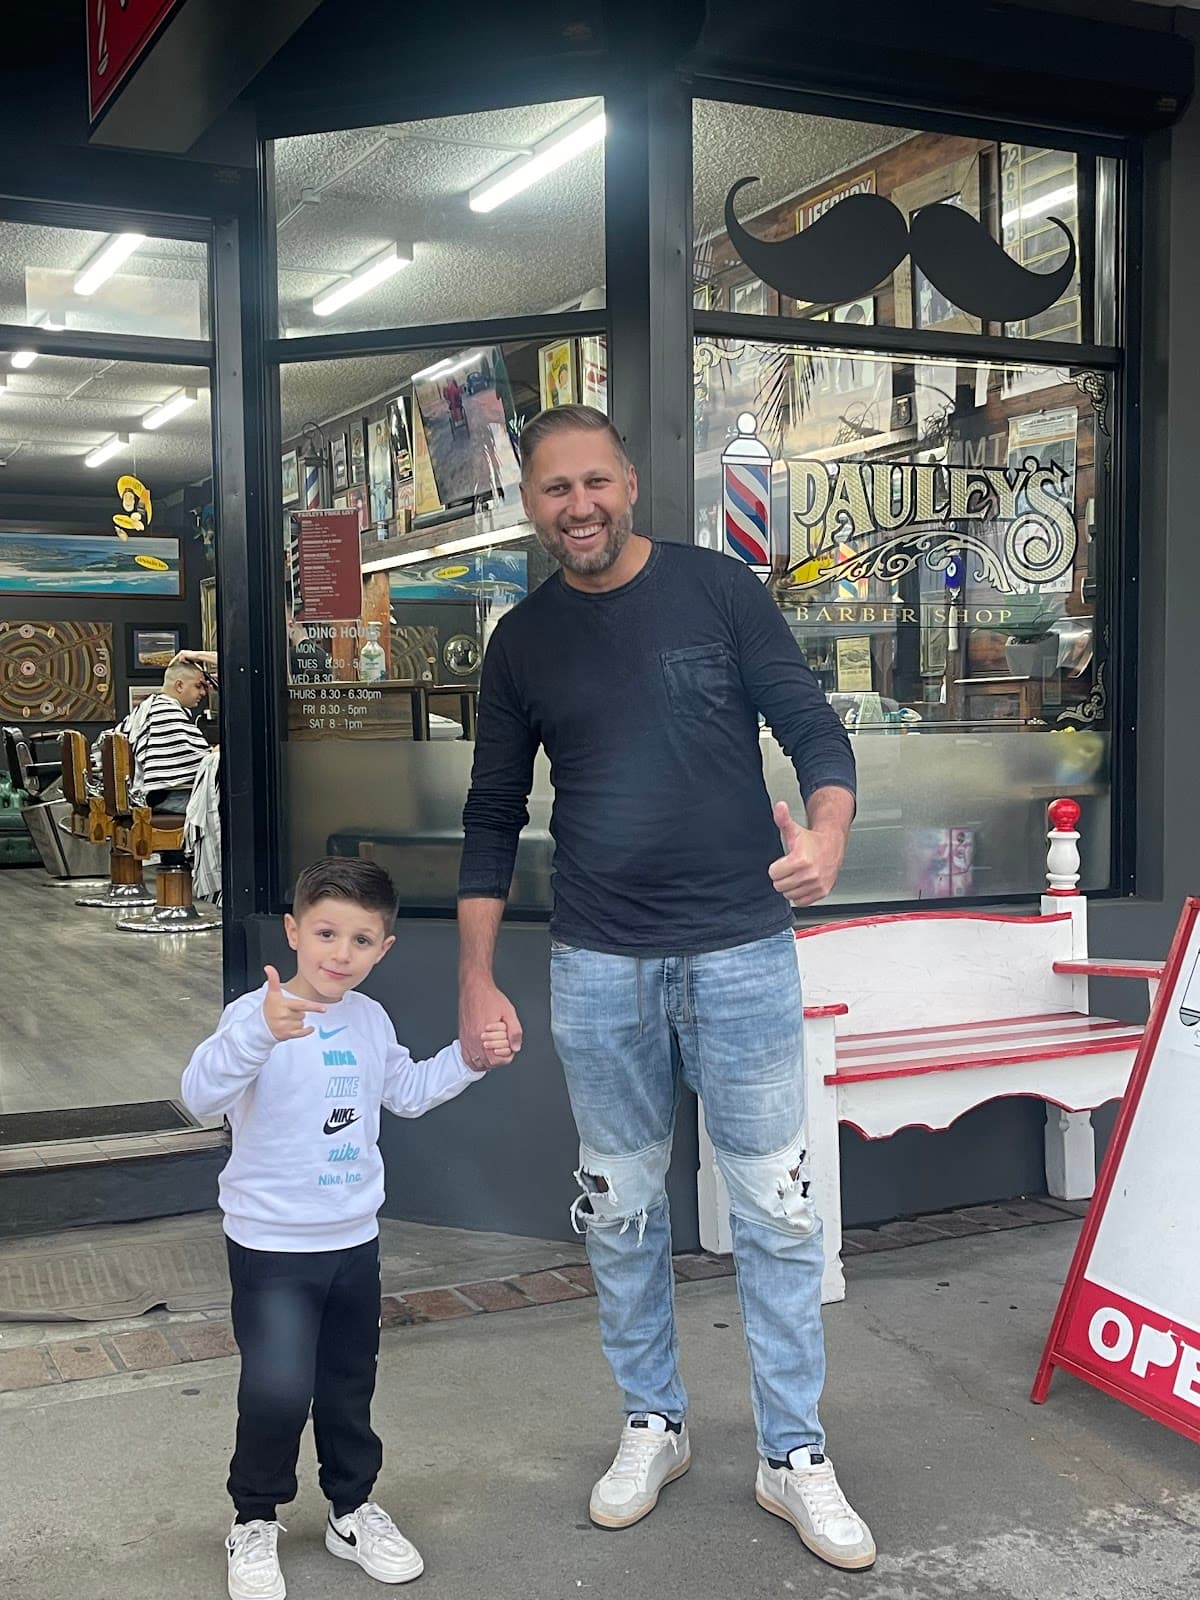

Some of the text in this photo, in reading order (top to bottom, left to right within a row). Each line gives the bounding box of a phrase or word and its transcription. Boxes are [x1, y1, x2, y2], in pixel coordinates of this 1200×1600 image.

[784, 455, 1078, 584] PAULEY'S
[795, 607, 1013, 624] BARBER SHOP
[340, 626, 381, 639] HOUS
[295, 643, 316, 654] MON
[297, 658, 318, 669] TUES
[288, 689, 316, 699] THURS
[320, 689, 341, 699] 8.30
[348, 689, 382, 701] 6.30pm
[302, 704, 316, 715] FRI
[319, 704, 341, 715] 8.30
[348, 705, 368, 717] 5pm
[309, 718, 325, 729] SAT
[329, 719, 336, 729] 8
[344, 718, 363, 731] 1pm
[322, 1049, 357, 1066] NIKE
[325, 1077, 360, 1098] NIKE
[329, 1108, 356, 1123] NIKE
[327, 1142, 361, 1162] nike
[318, 1174, 343, 1185] Nike,
